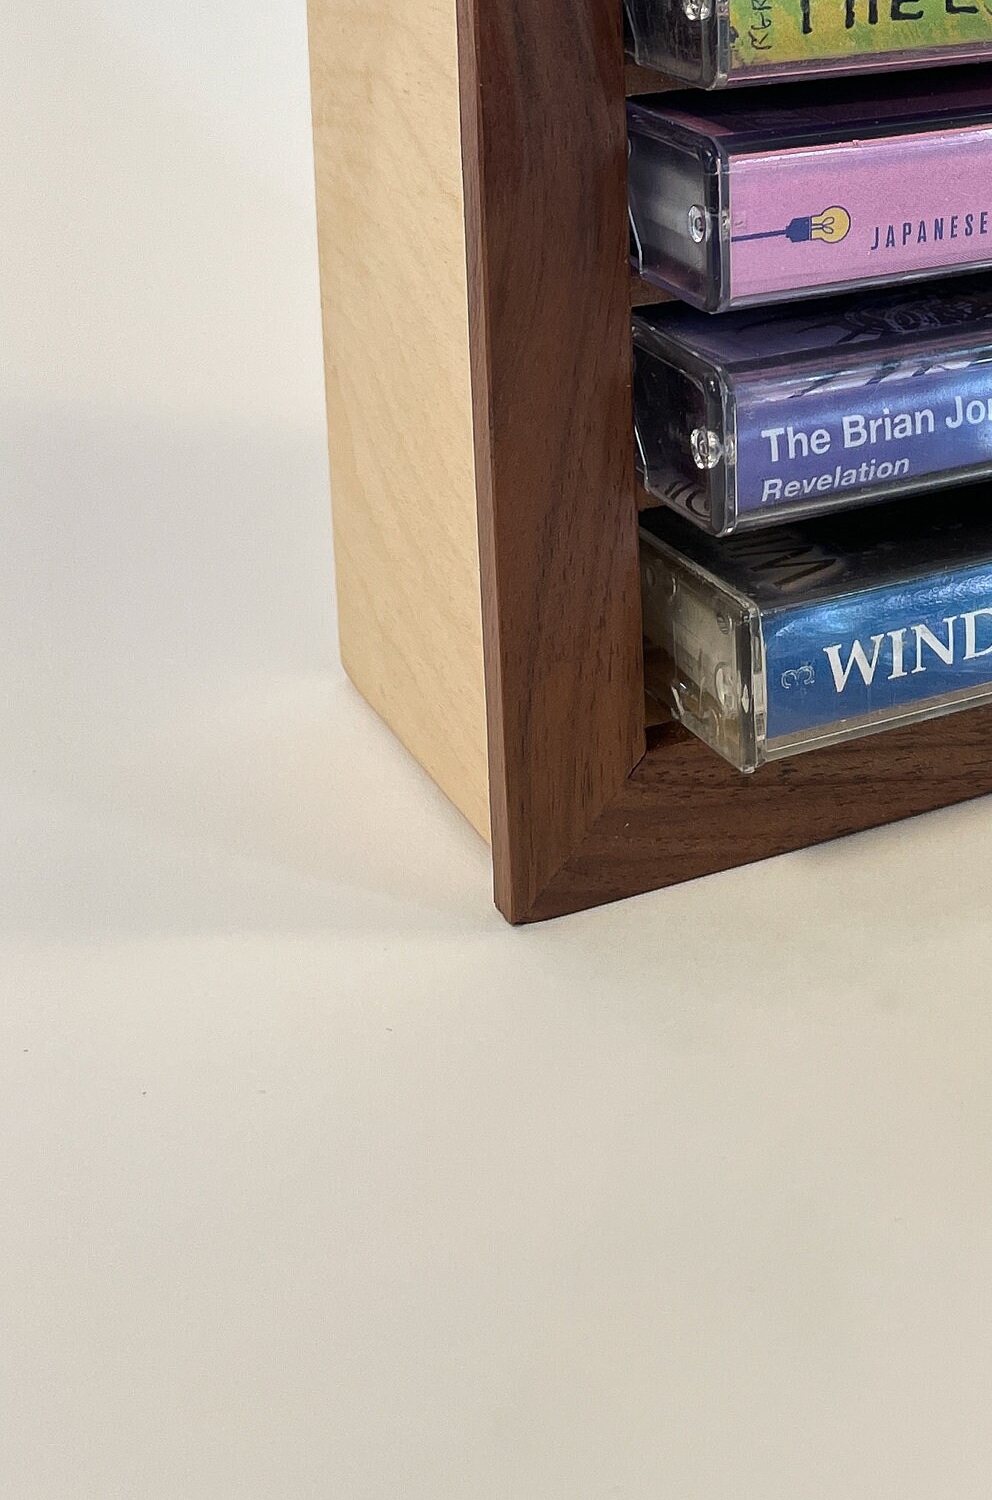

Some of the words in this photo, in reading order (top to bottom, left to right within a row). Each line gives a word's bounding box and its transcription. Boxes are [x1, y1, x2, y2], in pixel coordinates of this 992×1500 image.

[870, 211, 989, 251] JAPANESE
[761, 426, 831, 462] The
[842, 407, 935, 449] Brian
[761, 457, 910, 502] Revelation
